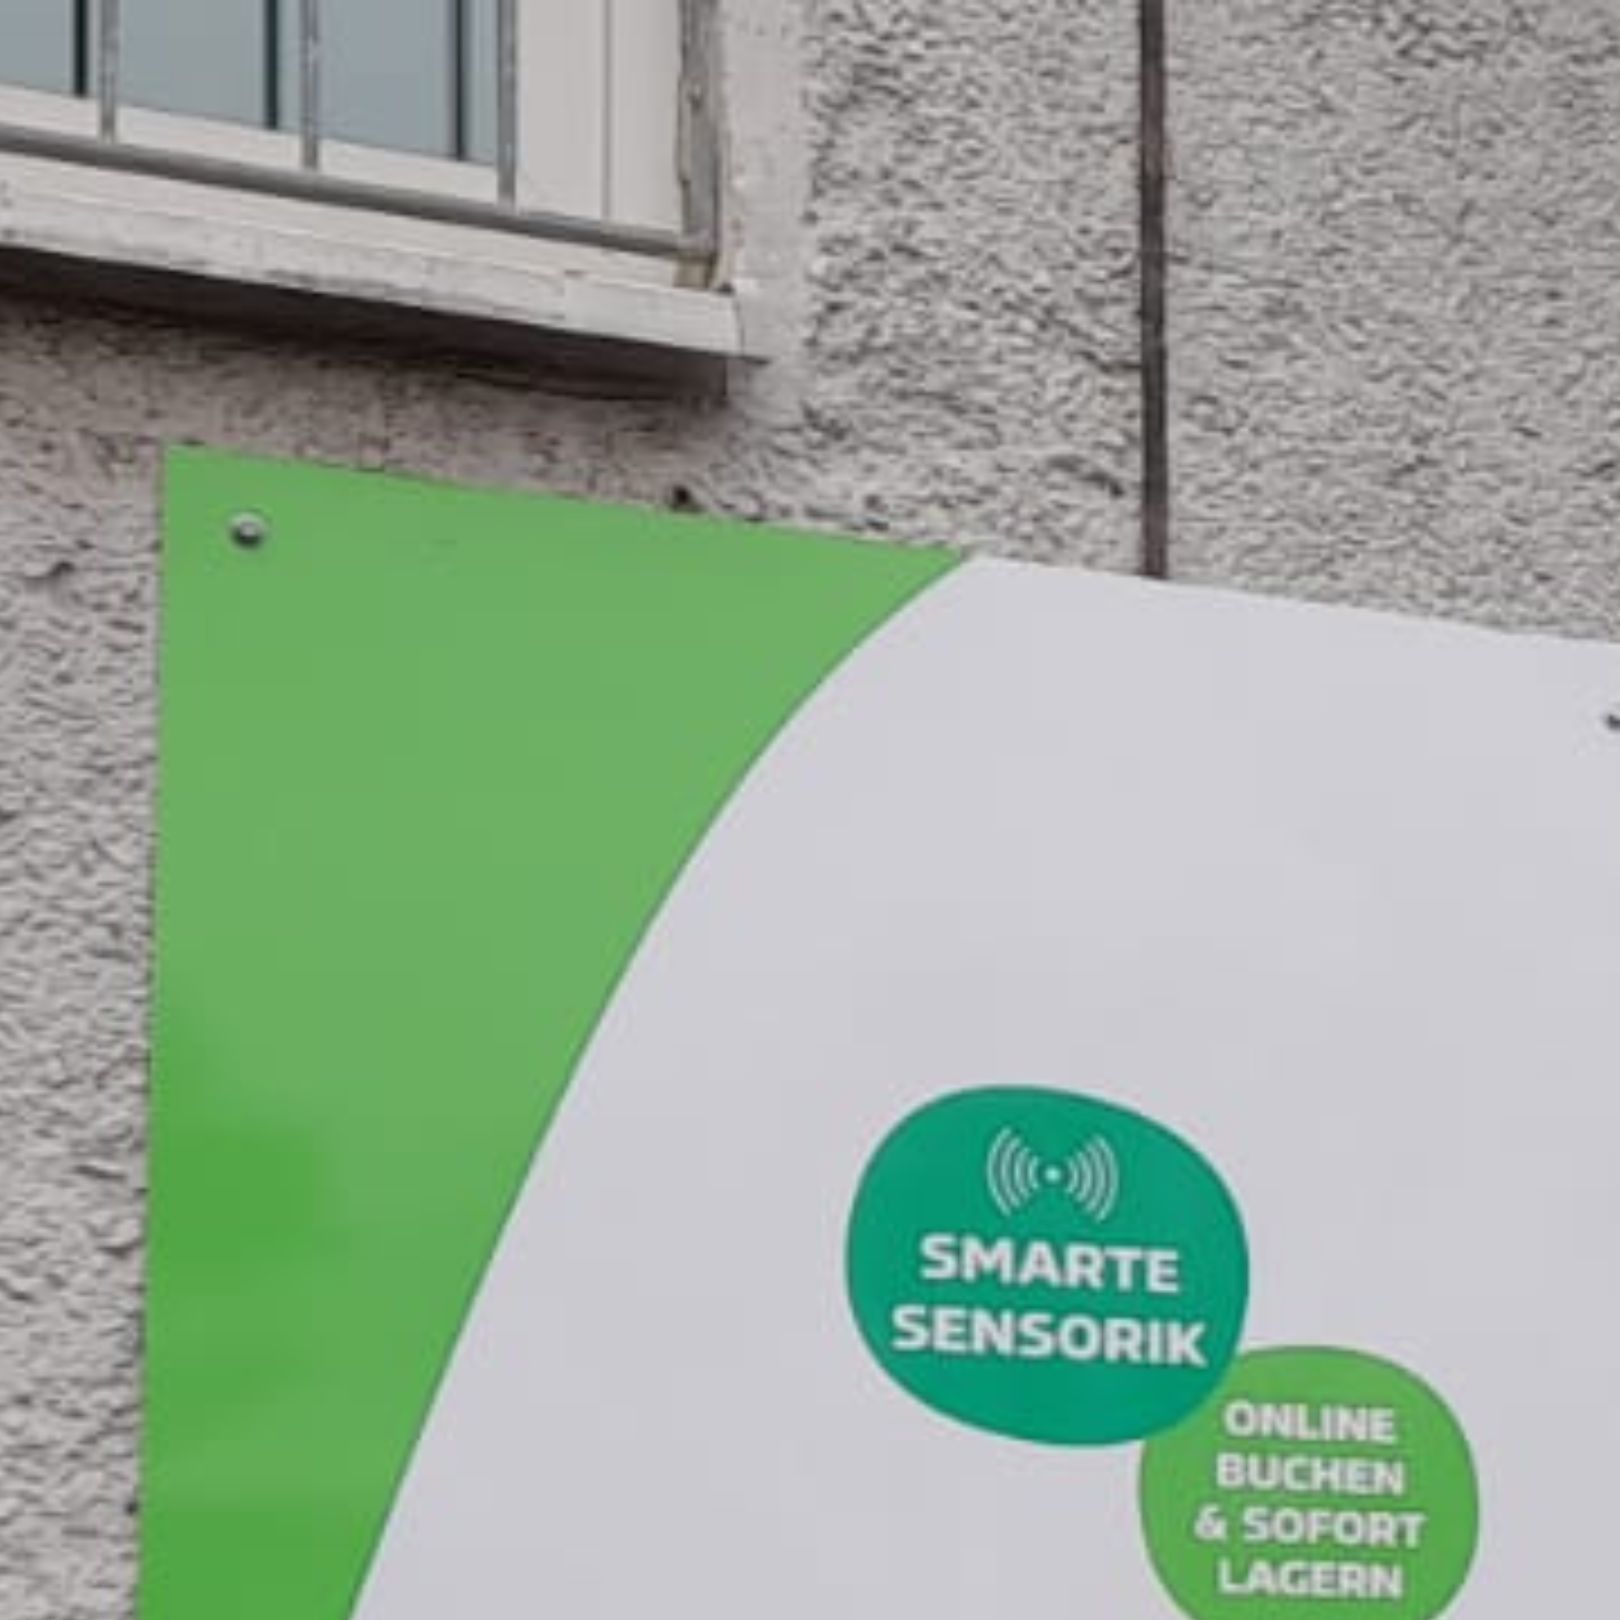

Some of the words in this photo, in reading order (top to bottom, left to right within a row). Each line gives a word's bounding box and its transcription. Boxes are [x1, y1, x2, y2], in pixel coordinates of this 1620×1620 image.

[919, 1233, 1181, 1294] SMARTE
[891, 1304, 1208, 1369] SENSORIK
[1222, 1398, 1397, 1444] ONLINE
[1214, 1451, 1406, 1497] BUCHEN
[1193, 1502, 1228, 1543] &
[1241, 1505, 1427, 1549] SOFORT
[1217, 1557, 1404, 1600] LAGERN
